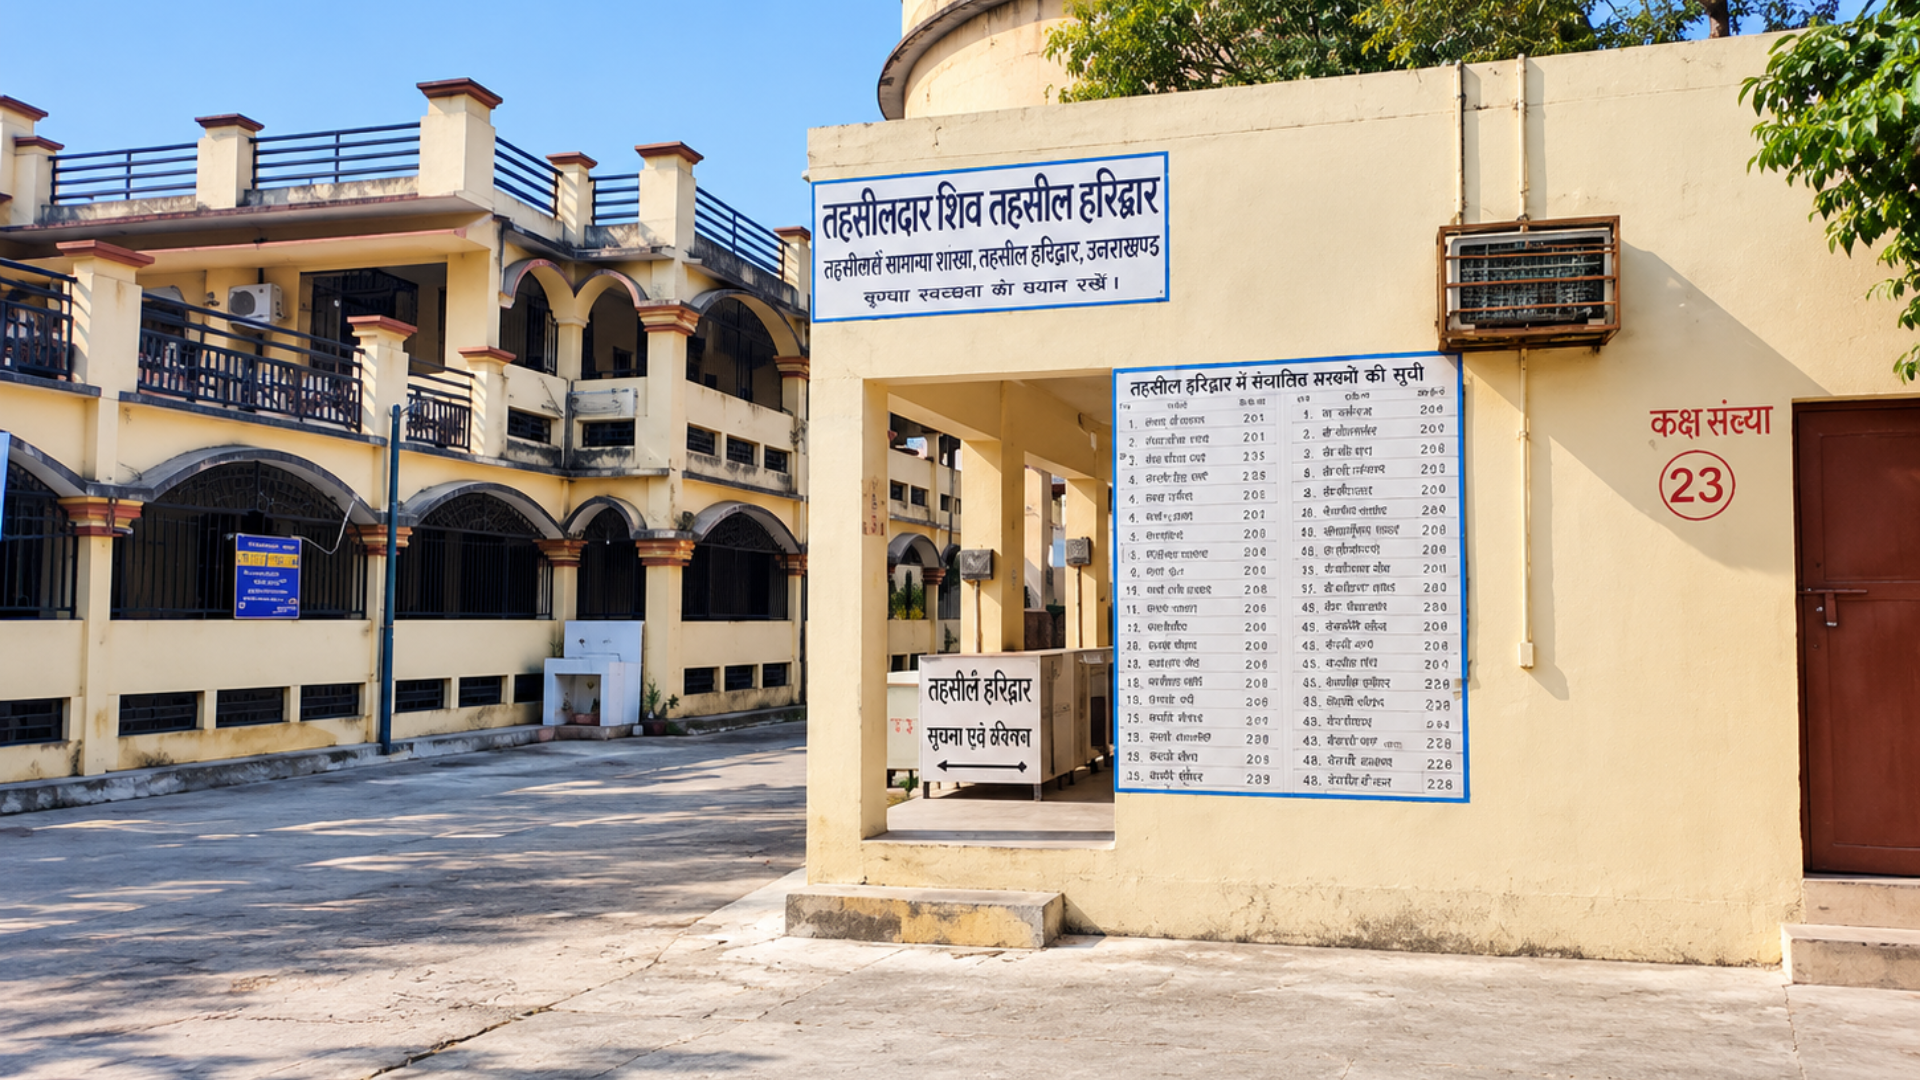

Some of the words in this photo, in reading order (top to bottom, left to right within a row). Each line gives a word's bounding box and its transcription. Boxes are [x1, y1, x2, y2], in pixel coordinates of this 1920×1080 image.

[823, 187, 933, 243] तहसीलदार
[936, 181, 984, 231] शिव
[989, 172, 1074, 230] तहसील
[1079, 167, 1160, 224] हरिद्वार
[978, 239, 1029, 270] तहसील
[1131, 375, 1182, 398] तहसील
[1236, 370, 1247, 390] में
[1364, 363, 1387, 384] की
[1129, 420, 1137, 429] 1.
[1129, 437, 1137, 447] 2.
[1243, 432, 1264, 442] 201
[1649, 409, 1703, 439] कक्ष
[1670, 467, 1724, 503] 23
